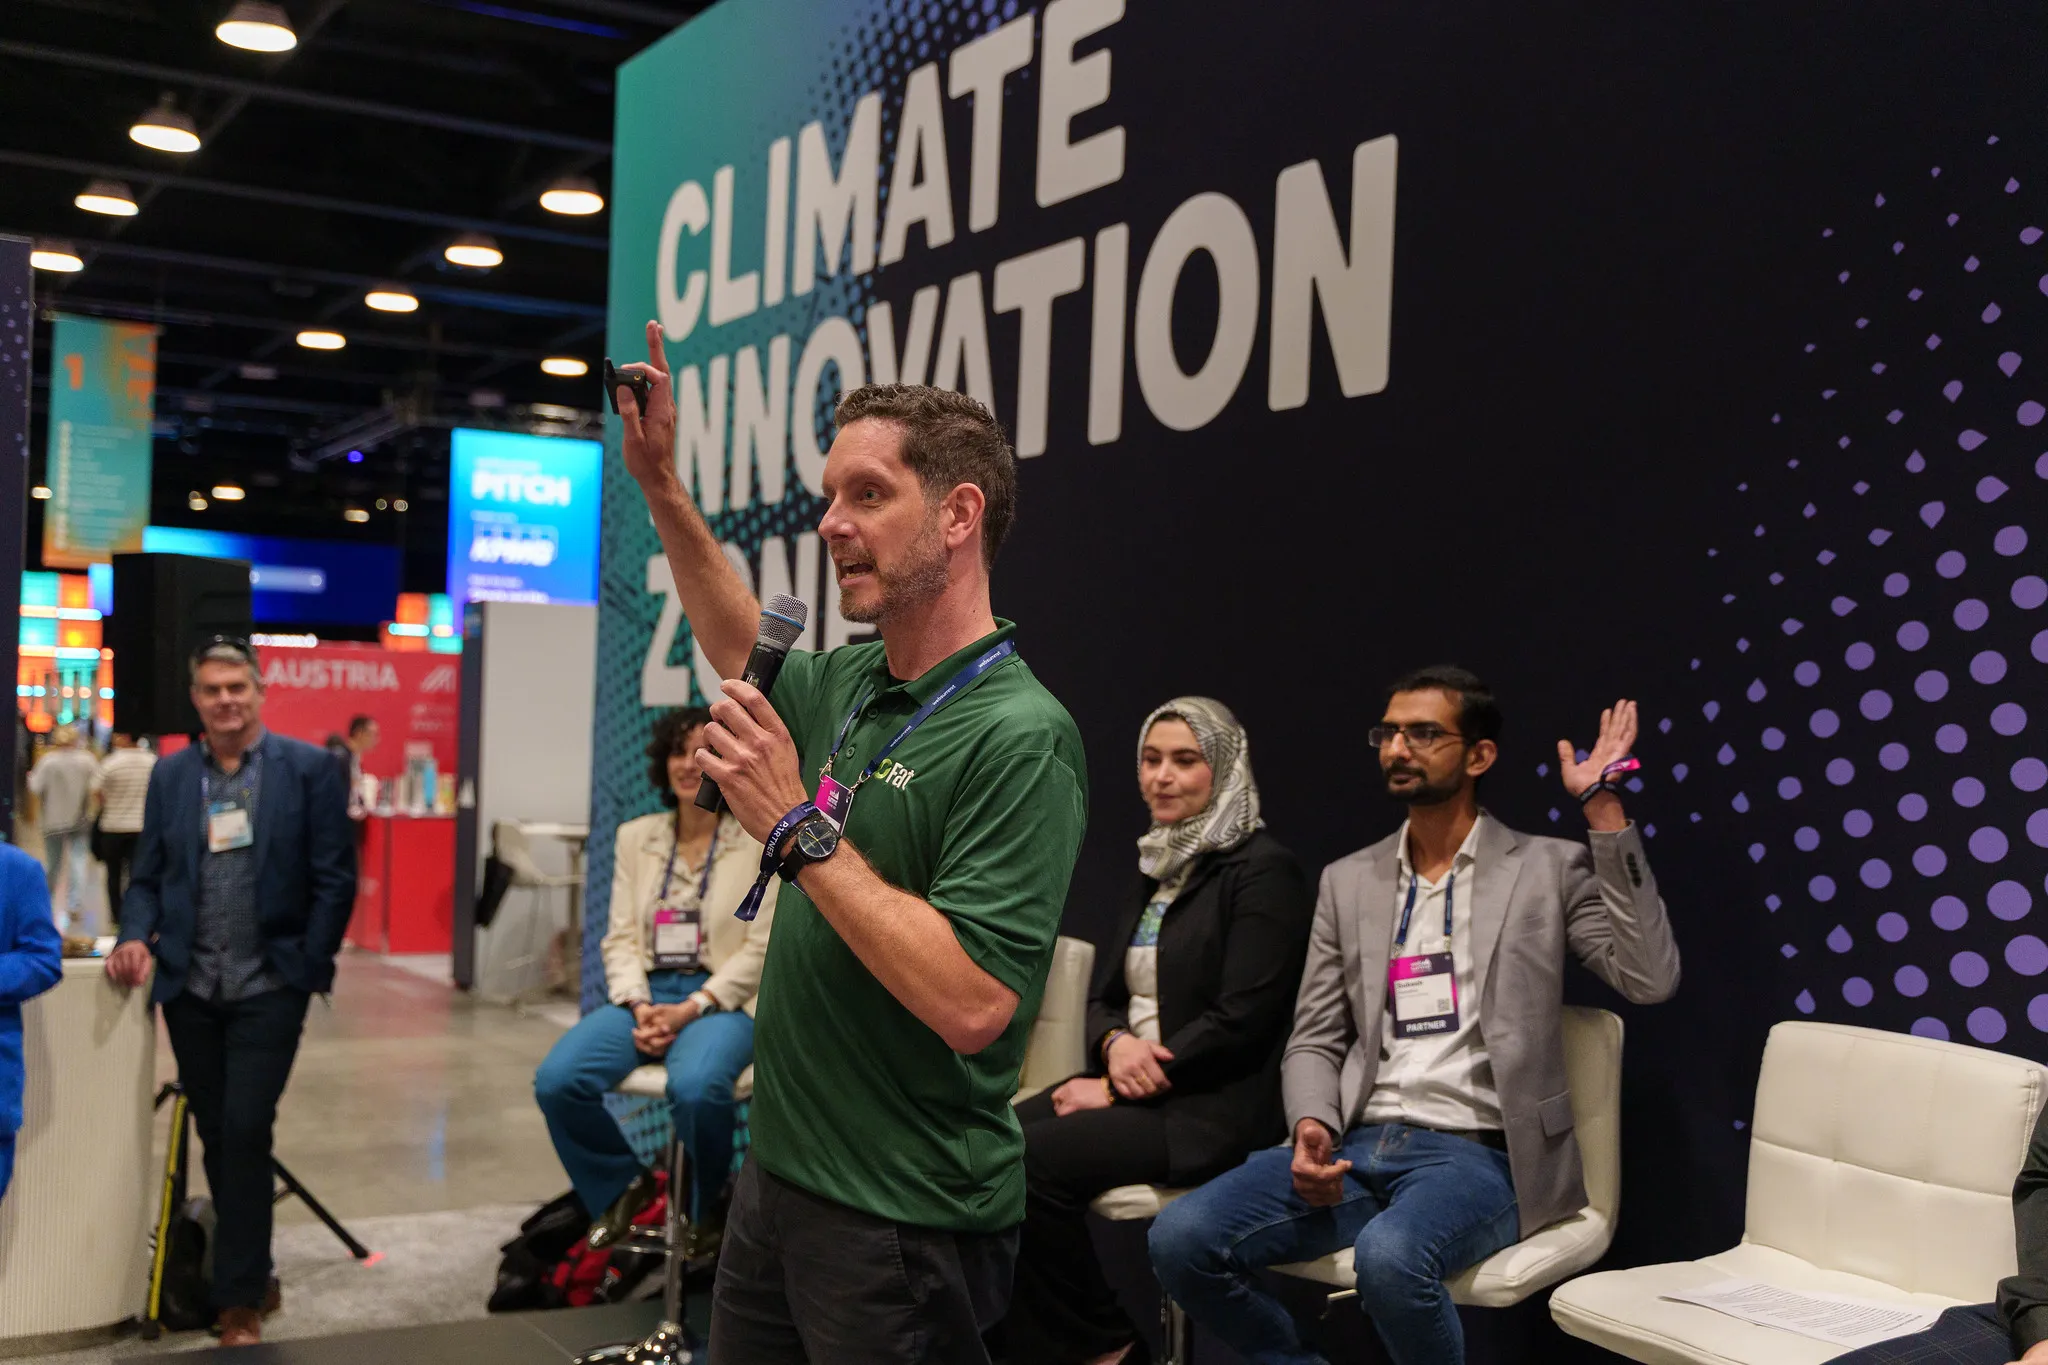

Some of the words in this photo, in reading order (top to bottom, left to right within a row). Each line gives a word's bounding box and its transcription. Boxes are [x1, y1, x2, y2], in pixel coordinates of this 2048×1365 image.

[657, 0, 1126, 342] CLIMATE
[649, 134, 1398, 525] NNOVATION
[472, 471, 571, 507] PITCH
[262, 657, 400, 692] AUSTRIA
[766, 820, 790, 858] PARTNER
[1406, 1019, 1447, 1033] PARTNER
